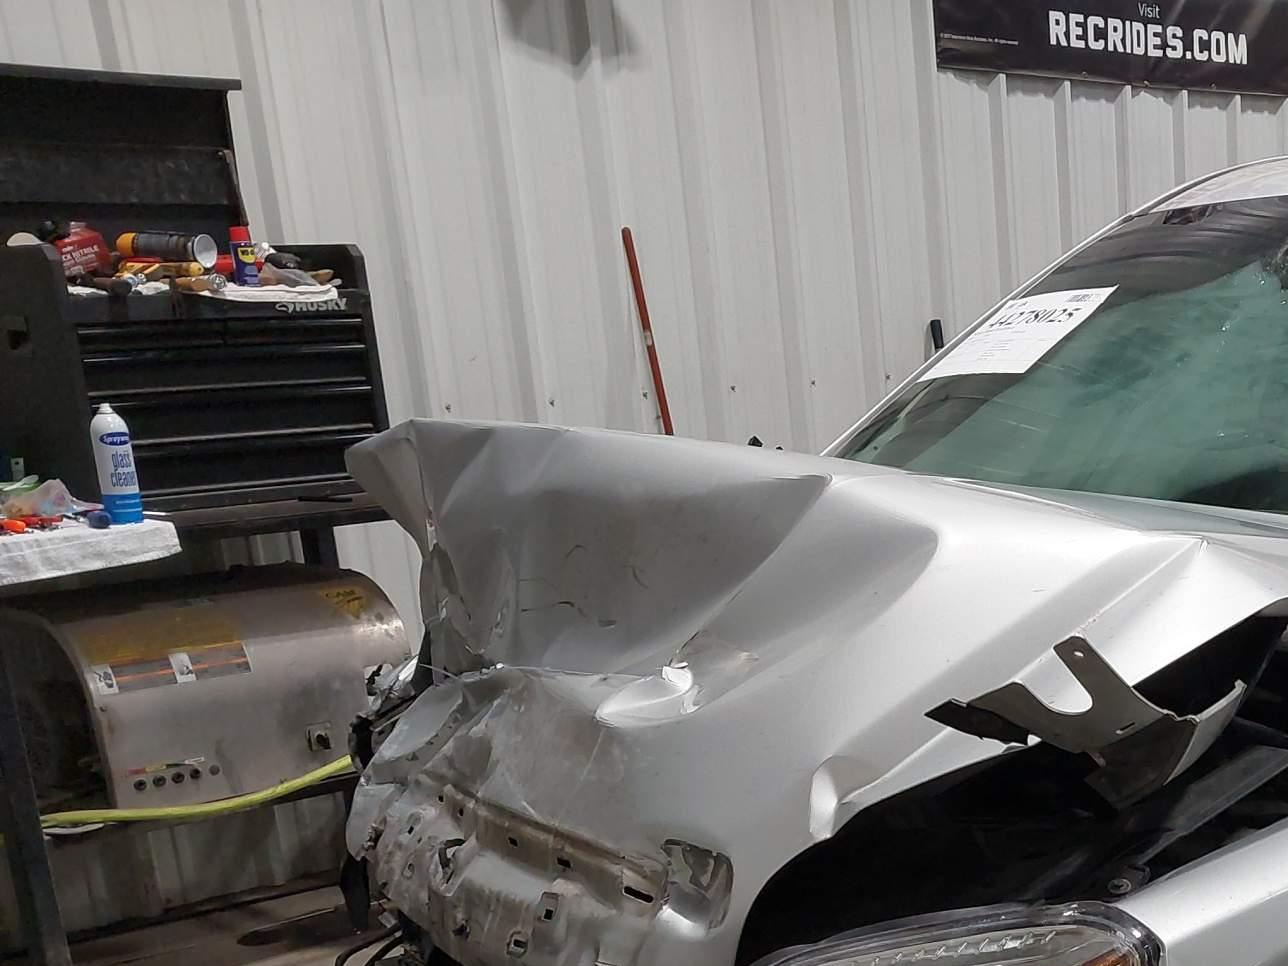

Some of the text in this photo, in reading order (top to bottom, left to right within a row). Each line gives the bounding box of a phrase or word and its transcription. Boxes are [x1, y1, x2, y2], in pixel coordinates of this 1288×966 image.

[1138, 2, 1160, 18] Visit
[1048, 10, 1248, 65] RECRIDES.COM
[295, 297, 347, 313] HUSKY
[989, 307, 1083, 328] 44278025
[111, 450, 132, 471] glass
